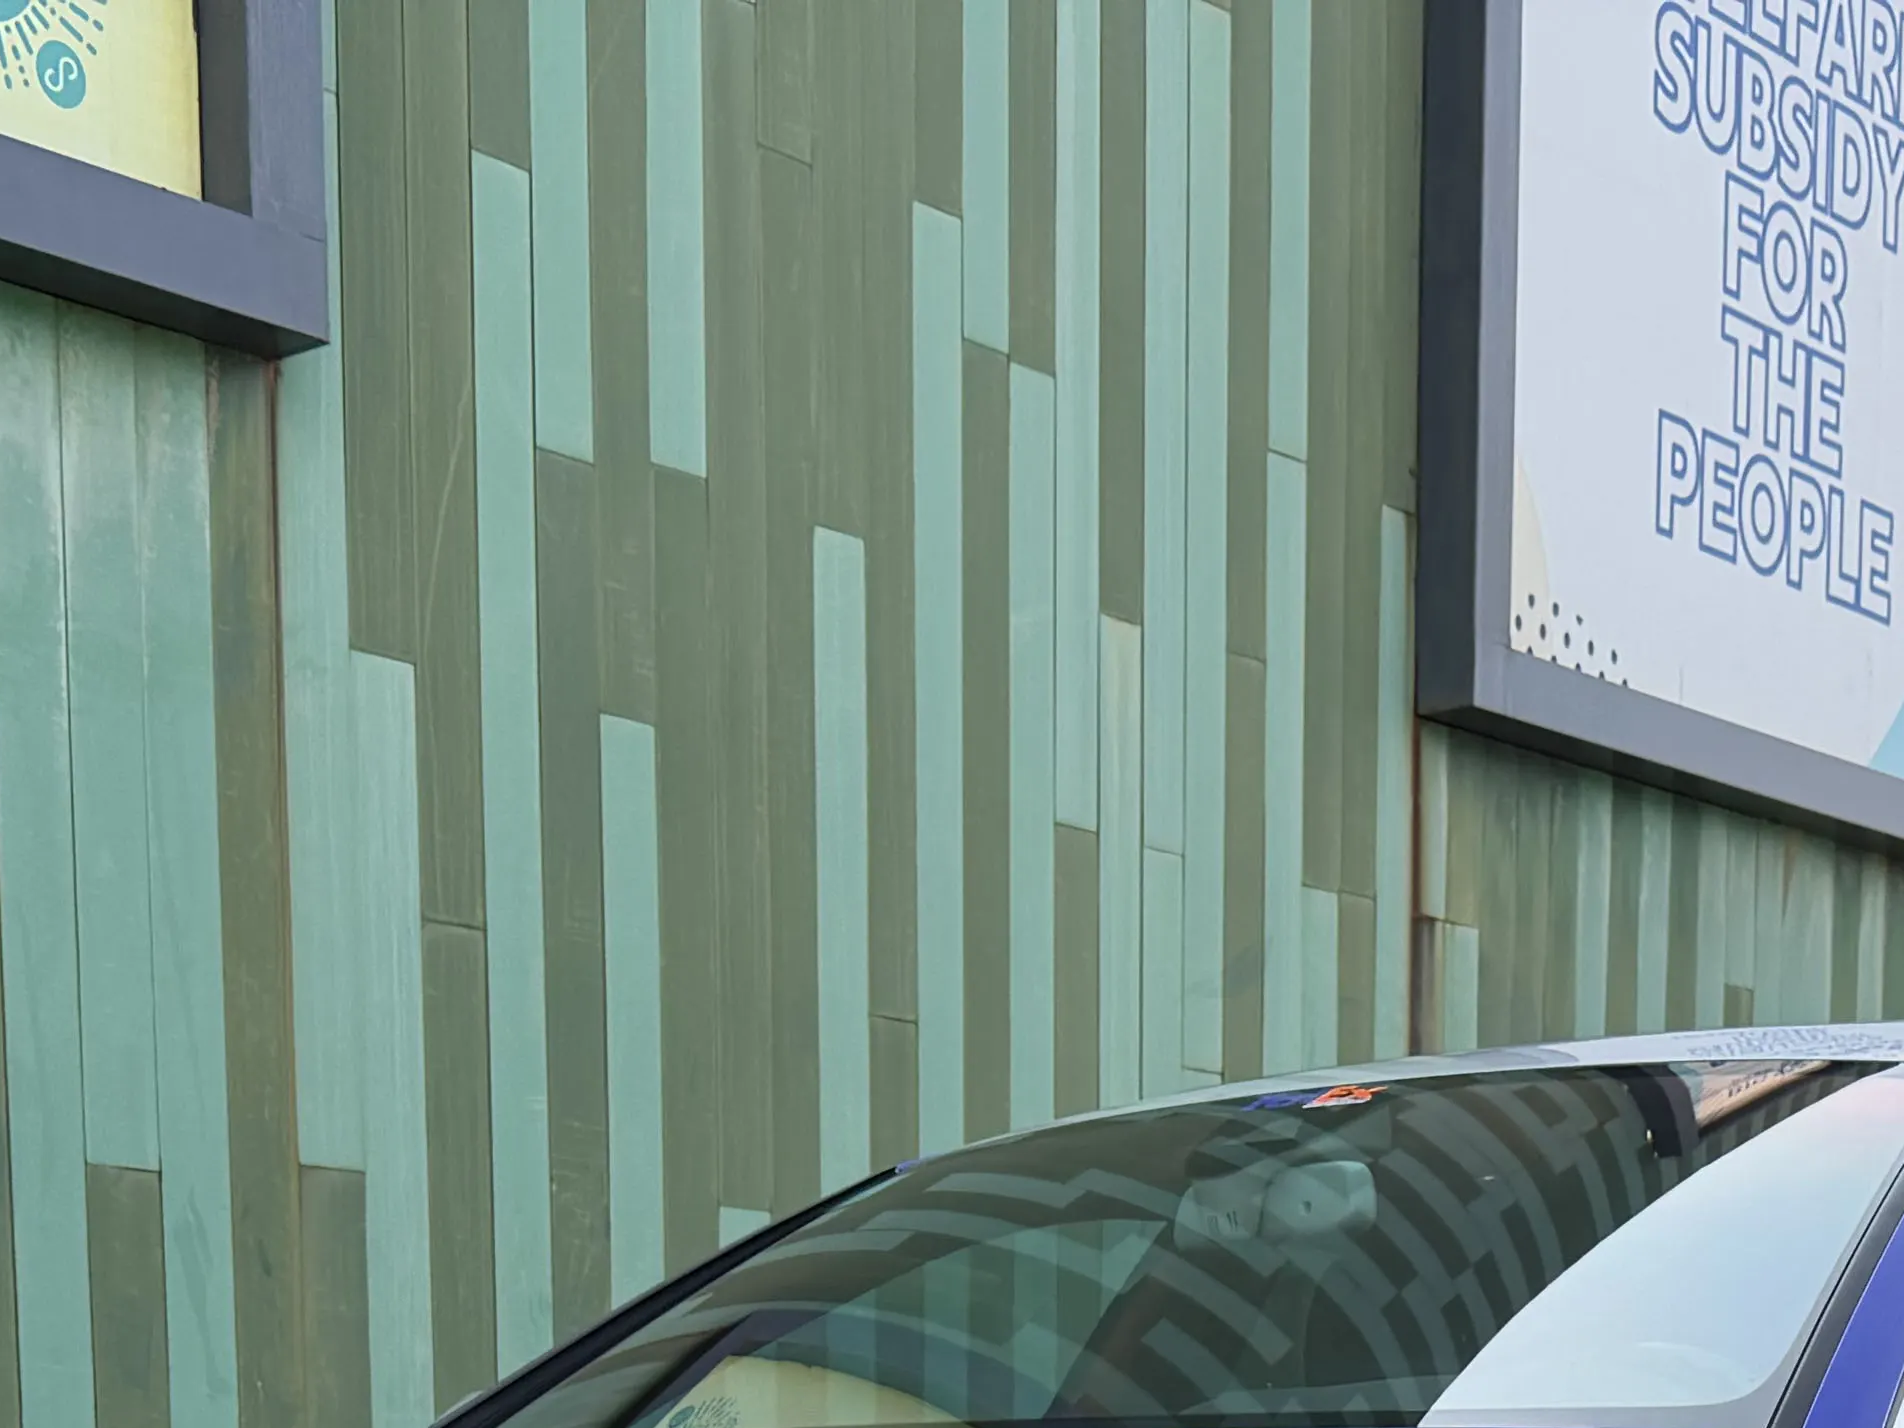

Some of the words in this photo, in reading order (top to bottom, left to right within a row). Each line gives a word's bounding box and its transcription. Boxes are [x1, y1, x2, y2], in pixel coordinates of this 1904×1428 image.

[1722, 170, 1847, 354] FOR
[1720, 303, 1845, 476] THE
[1655, 409, 1895, 625] PEOPLE
